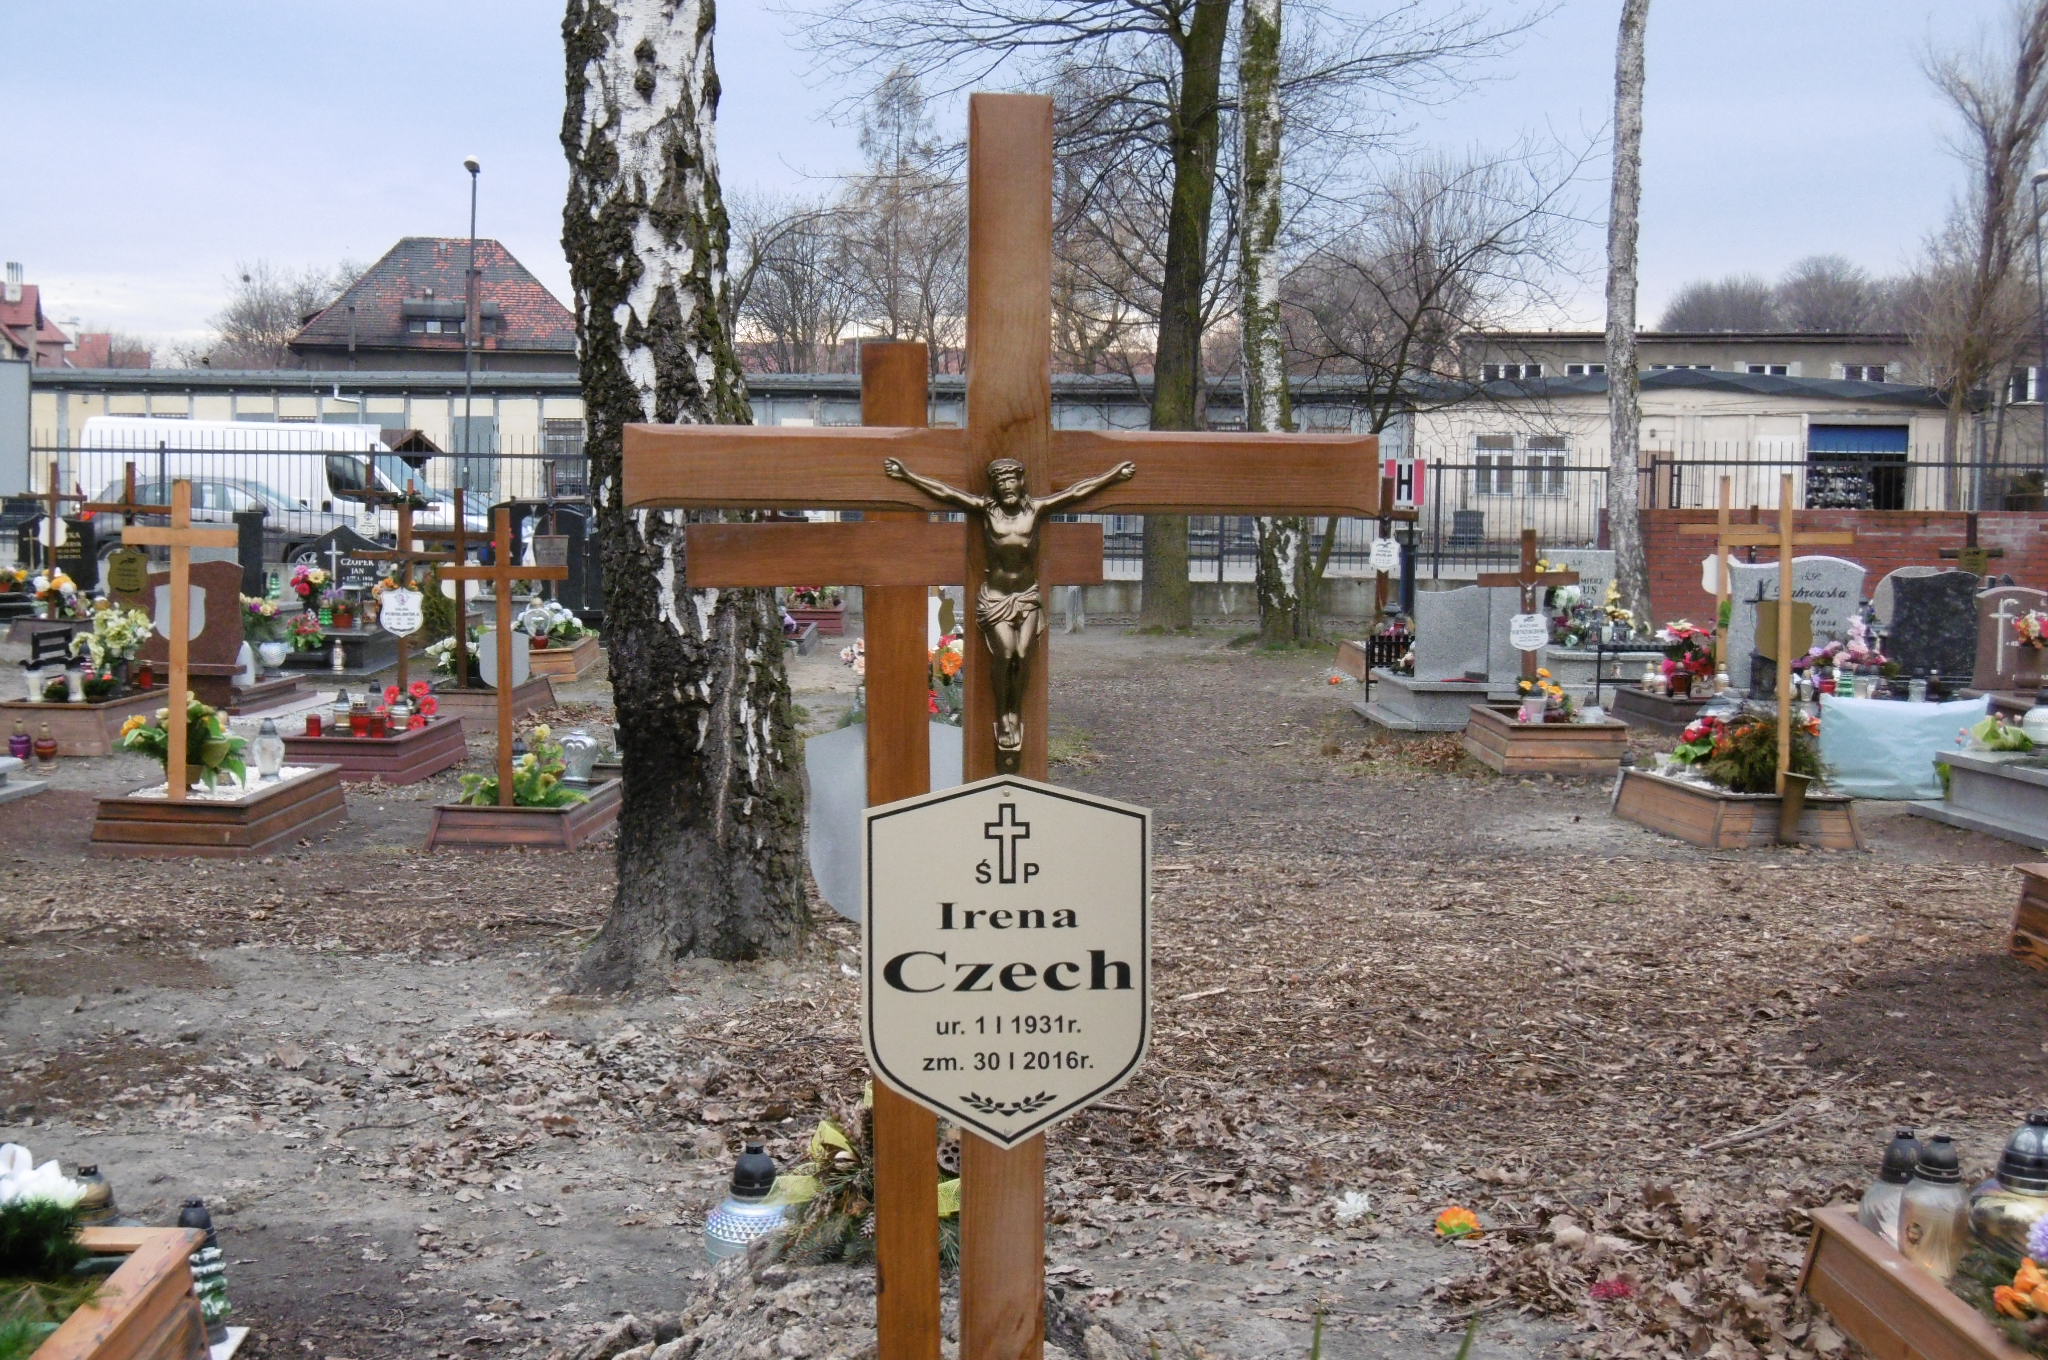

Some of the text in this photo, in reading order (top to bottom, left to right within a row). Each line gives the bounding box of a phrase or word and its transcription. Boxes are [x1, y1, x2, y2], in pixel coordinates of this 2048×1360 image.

[1396, 464, 1413, 501] H
[975, 859, 1040, 885] Ś P
[937, 902, 1079, 930] Irena
[883, 949, 1135, 994] Czech
[936, 1020, 965, 1036] ur.
[975, 1015, 985, 1035] 1
[1011, 1014, 1082, 1035] 1931r.
[922, 1056, 964, 1072] zm.
[973, 1051, 1001, 1071] 30
[1023, 1050, 1094, 1071] 2016r.
